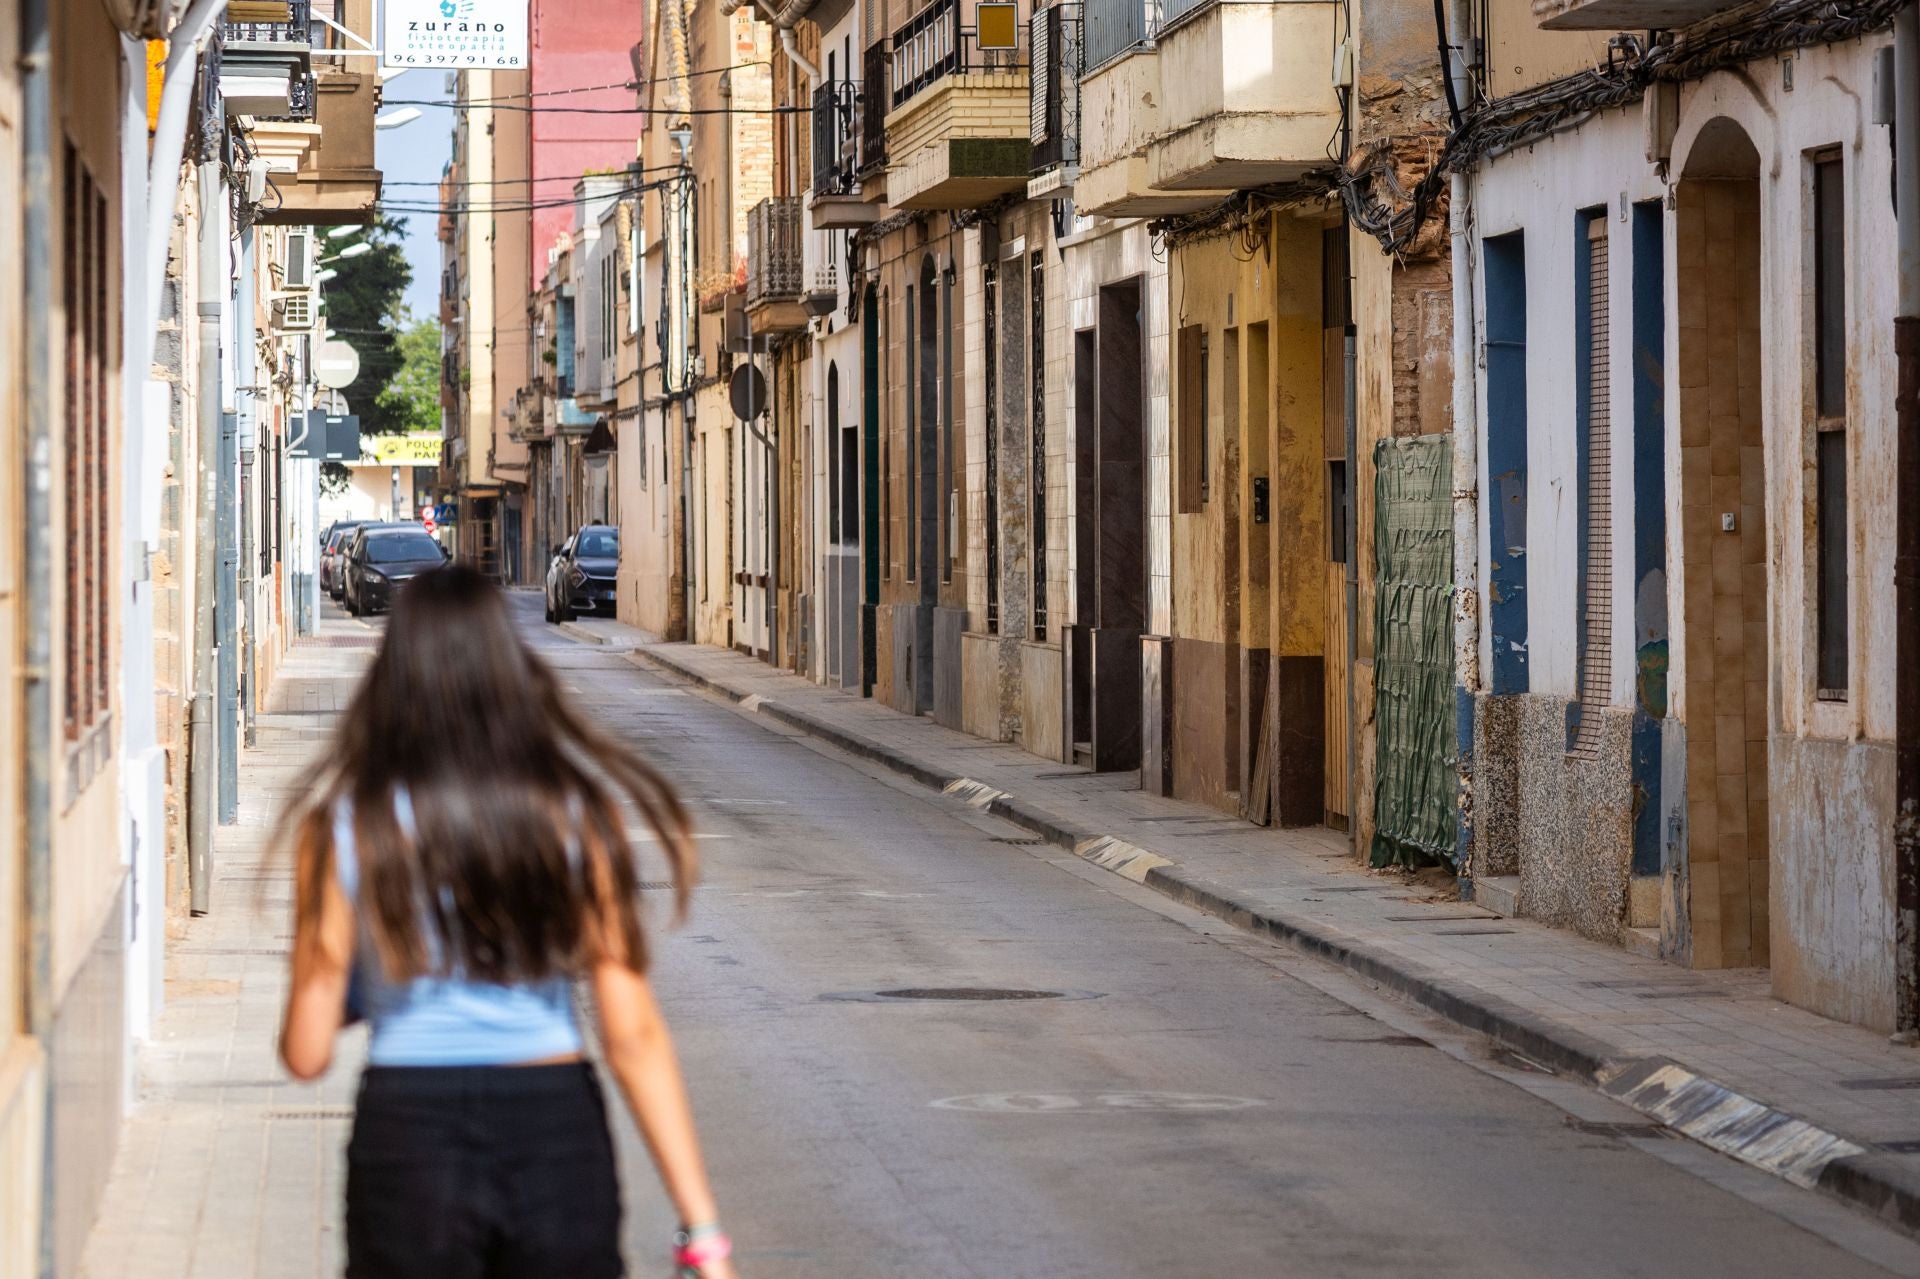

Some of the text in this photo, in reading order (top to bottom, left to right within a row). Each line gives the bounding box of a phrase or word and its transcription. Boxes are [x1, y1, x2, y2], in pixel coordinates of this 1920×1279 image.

[408, 21, 504, 32] zurano
[408, 33, 504, 43] fisioterapia
[394, 54, 416, 63] 96
[424, 55, 458, 64] 397
[497, 56, 519, 65] 68
